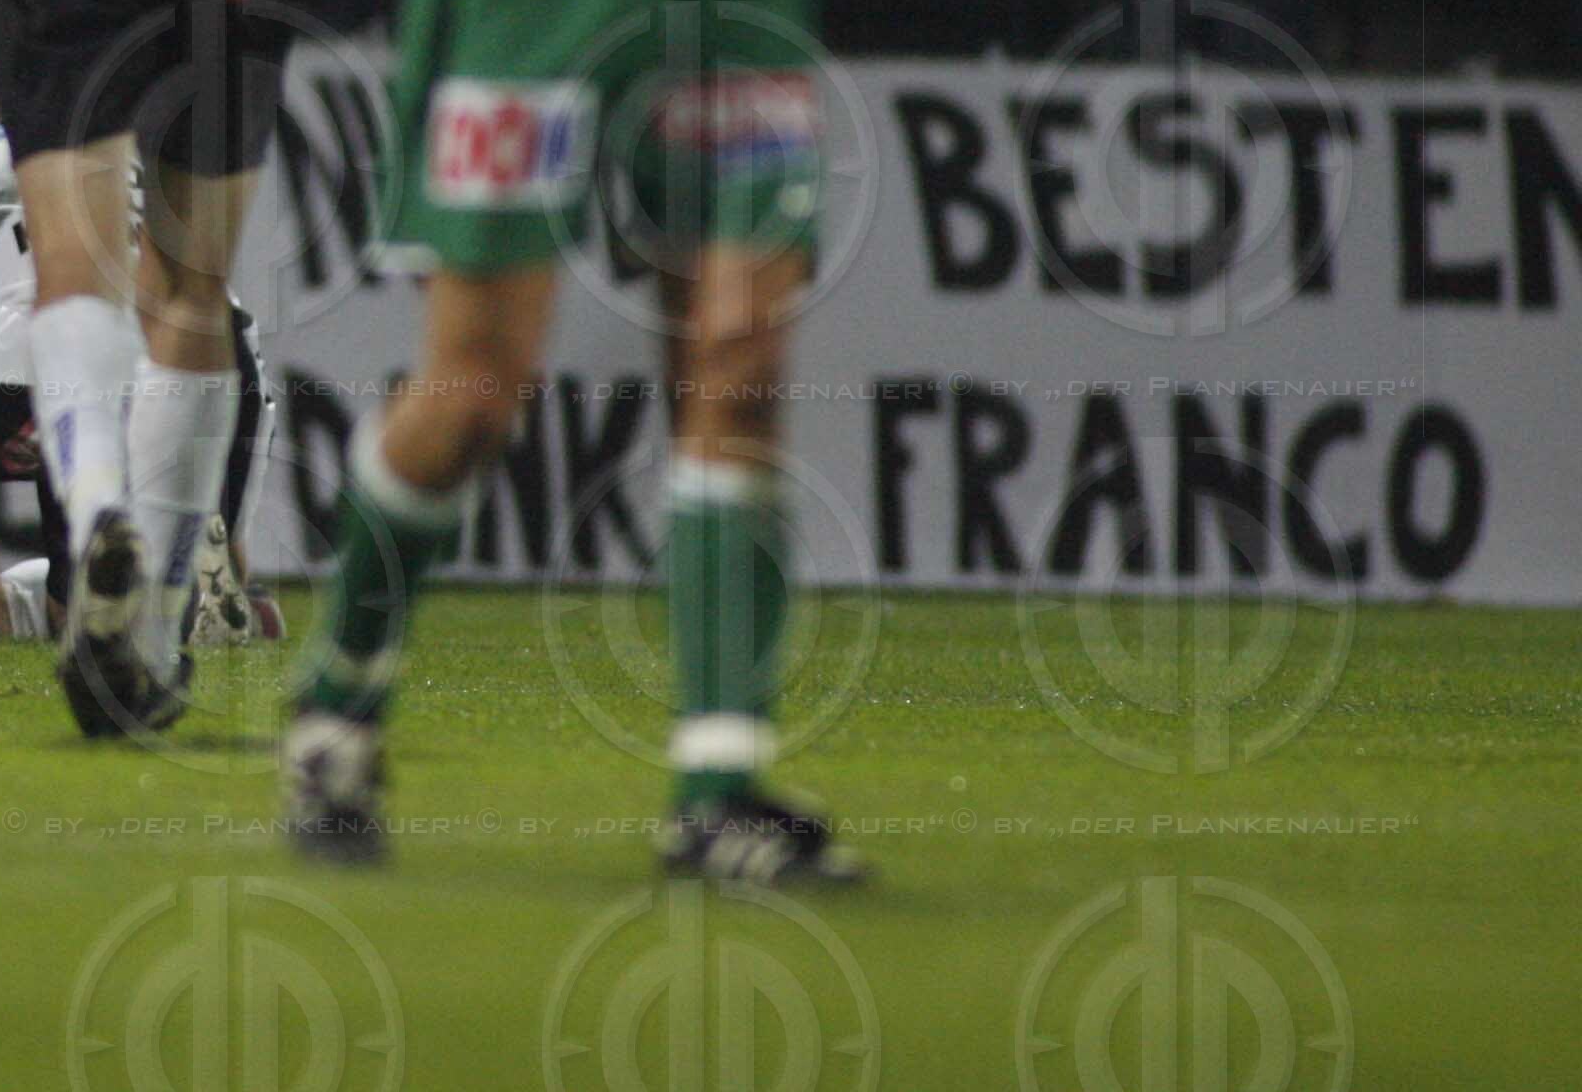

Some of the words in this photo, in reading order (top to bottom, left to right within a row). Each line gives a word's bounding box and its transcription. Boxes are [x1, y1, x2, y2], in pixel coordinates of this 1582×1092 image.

[893, 86, 1582, 312] BESTEN
[284, 361, 658, 570] DNK
[871, 371, 1489, 586] FRANCO
